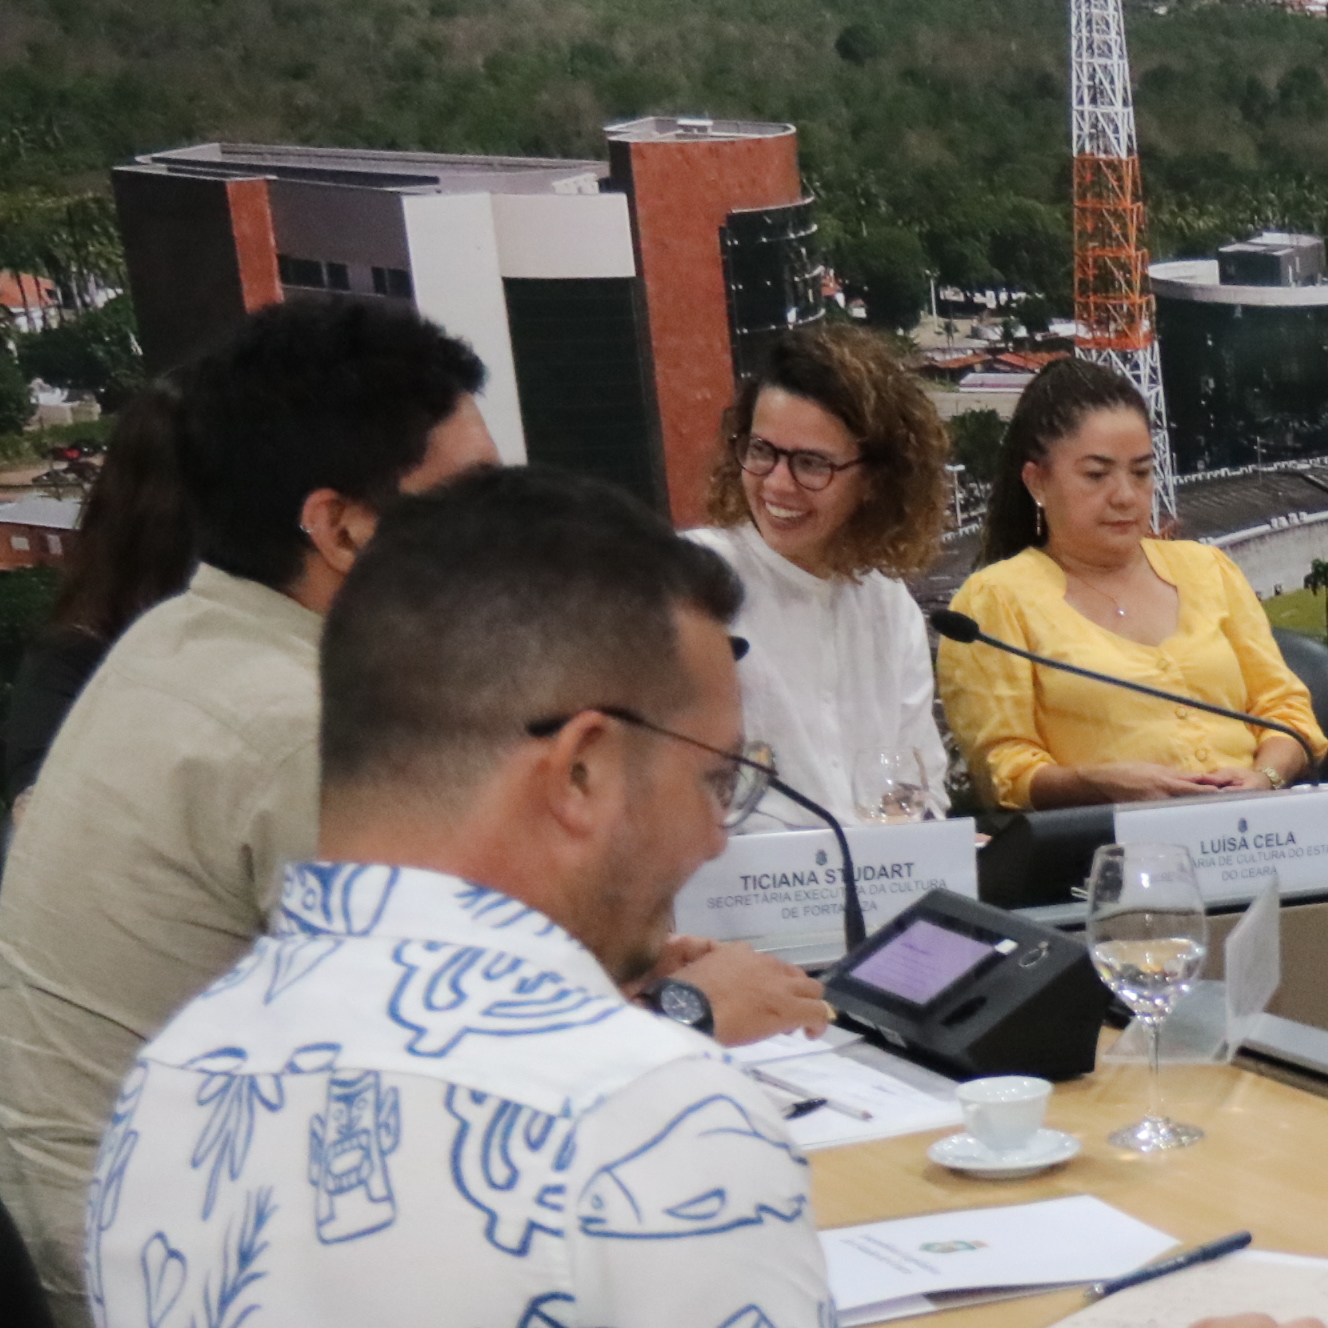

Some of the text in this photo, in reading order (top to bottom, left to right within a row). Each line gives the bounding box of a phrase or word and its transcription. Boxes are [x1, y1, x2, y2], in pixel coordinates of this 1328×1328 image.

[1200, 831, 1297, 854] LUÍSA CELA
[1218, 856, 1233, 866] DE
[1236, 850, 1286, 864] CULTURA
[1288, 847, 1304, 858] DO
[741, 869, 818, 890] TICIANA
[1221, 870, 1238, 881] DO
[794, 885, 866, 901] EXECUTA
[869, 884, 886, 895] DA
[890, 878, 948, 893] CULTURA
[782, 902, 878, 919] DE FORTAZA
